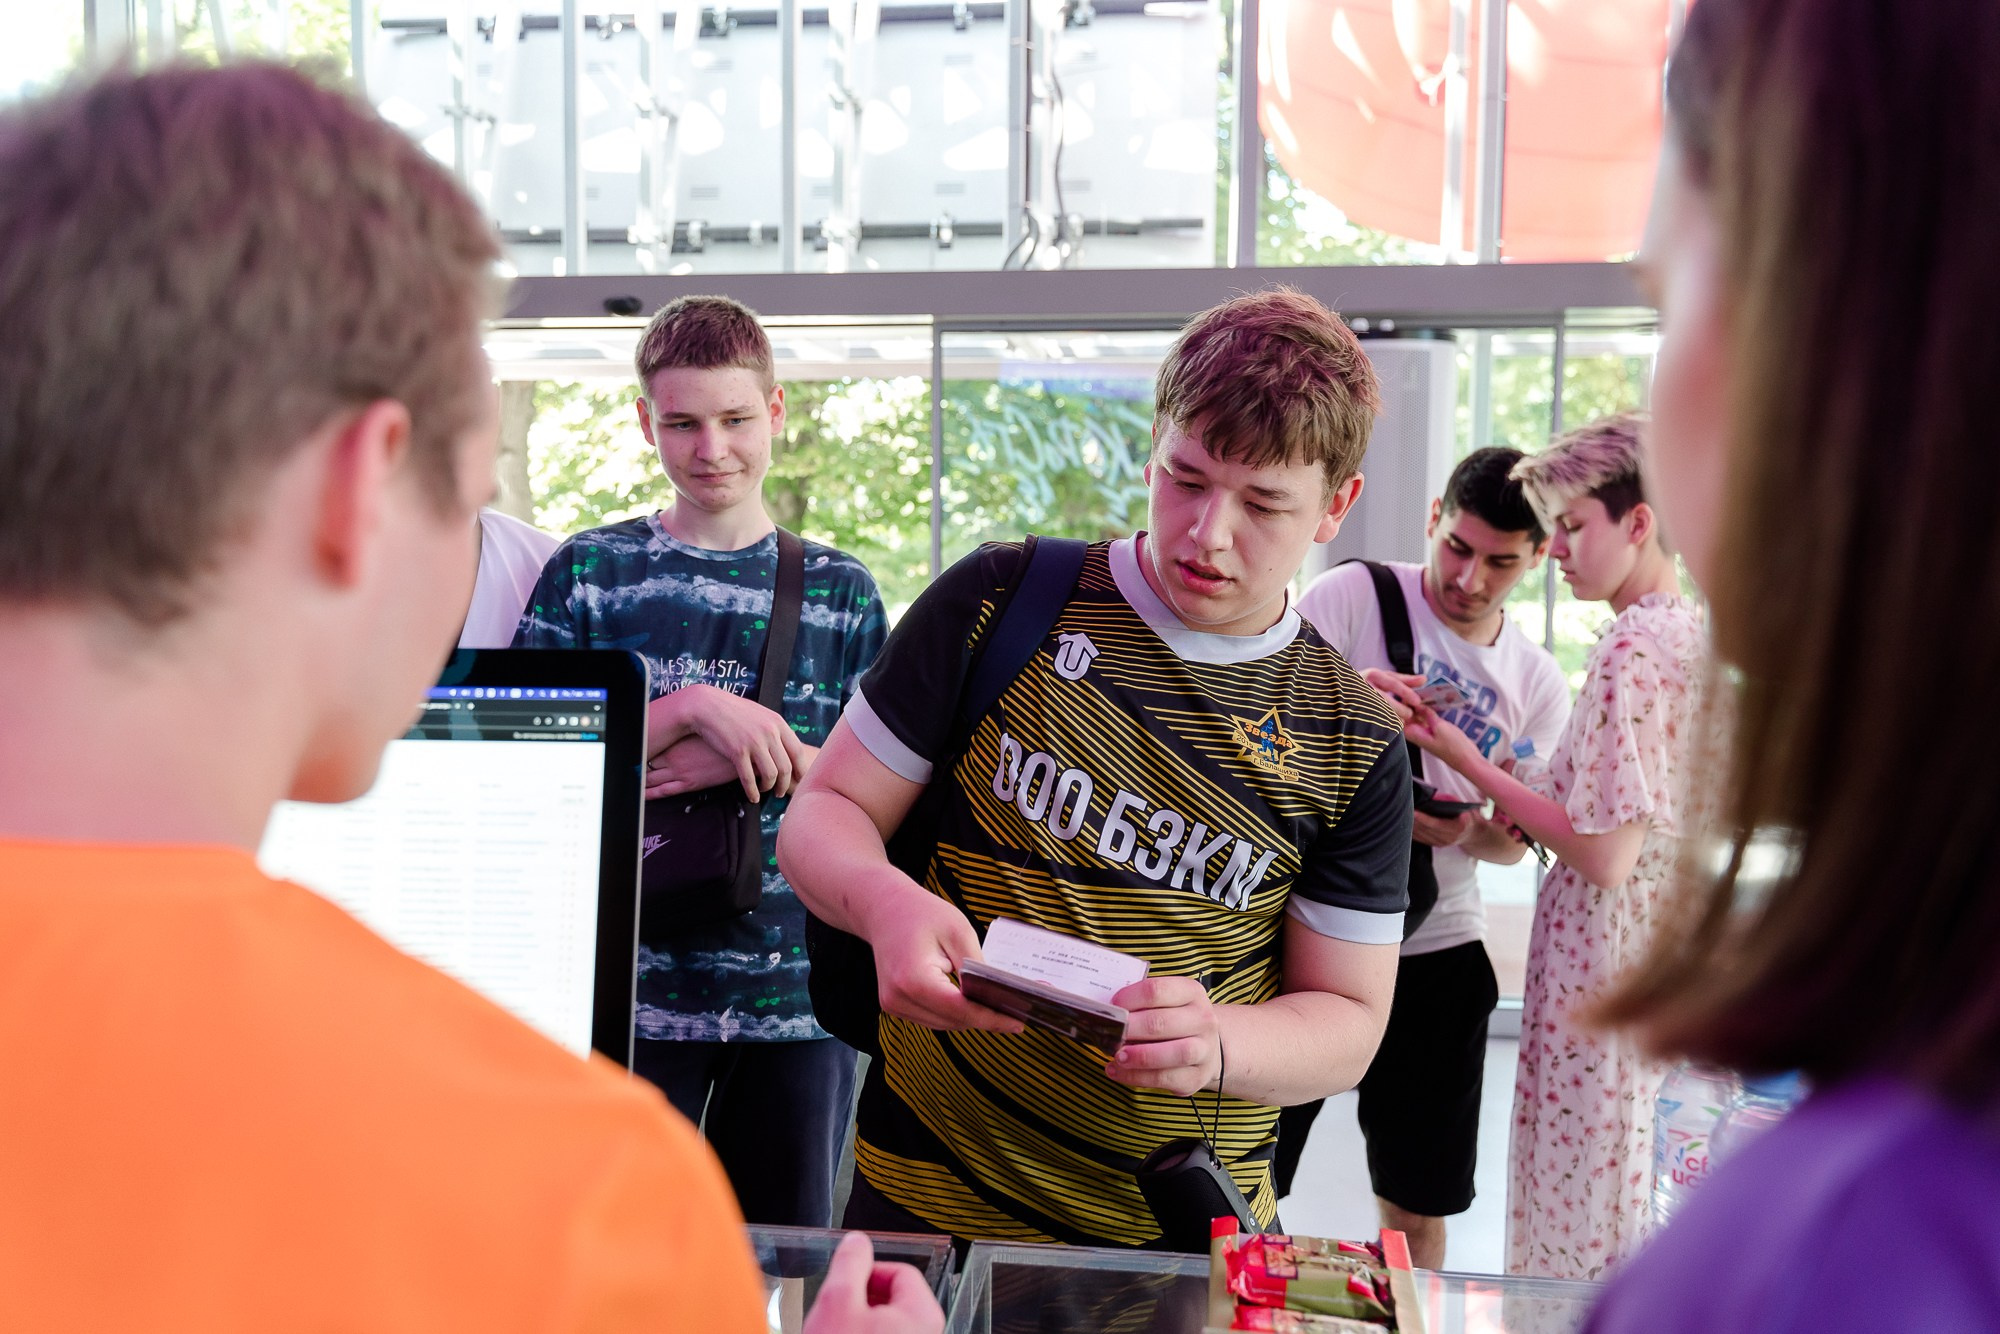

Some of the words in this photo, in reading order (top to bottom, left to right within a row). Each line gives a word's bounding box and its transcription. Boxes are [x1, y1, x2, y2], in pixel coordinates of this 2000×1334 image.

[660, 657, 692, 675] LESS
[696, 659, 748, 678] PLASTIC
[1243, 722, 1293, 748] Звезда
[992, 732, 1094, 841] ООО
